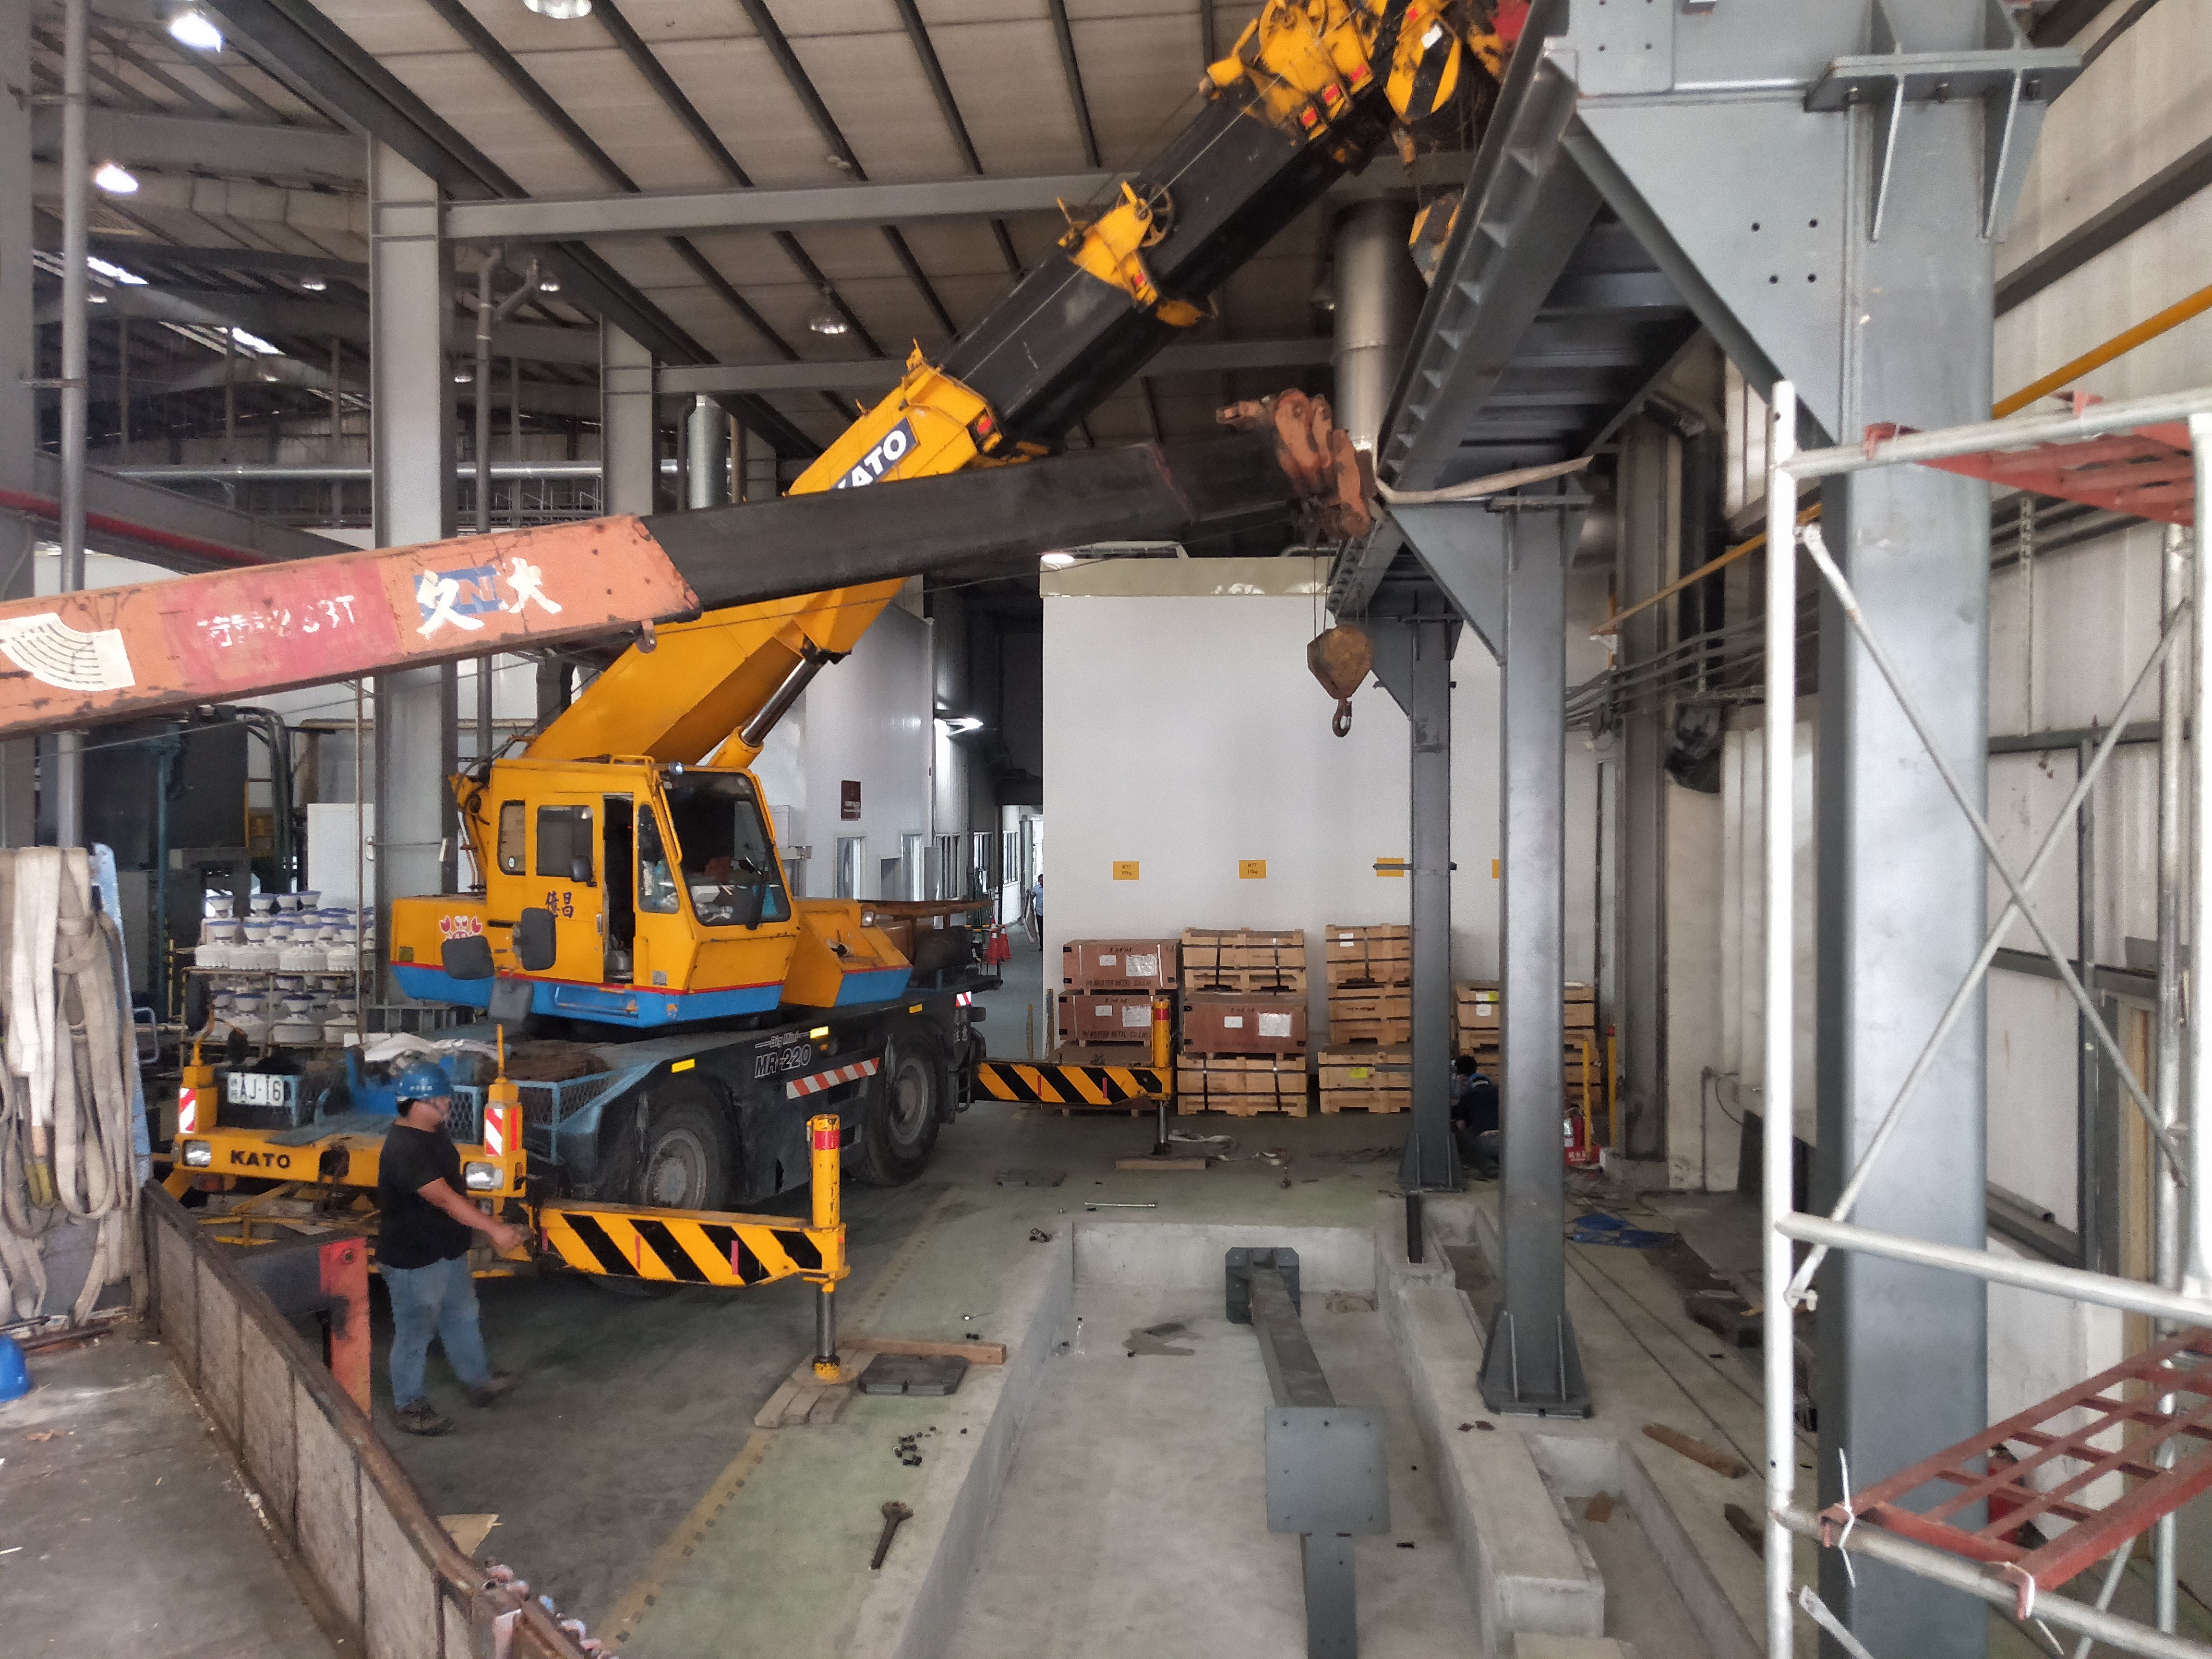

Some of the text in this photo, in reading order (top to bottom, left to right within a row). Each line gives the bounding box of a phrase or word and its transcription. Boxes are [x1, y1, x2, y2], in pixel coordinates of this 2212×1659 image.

[838, 430, 907, 490] ATO
[770, 1034, 783, 1048] Big
[230, 1150, 291, 1169] KATO
